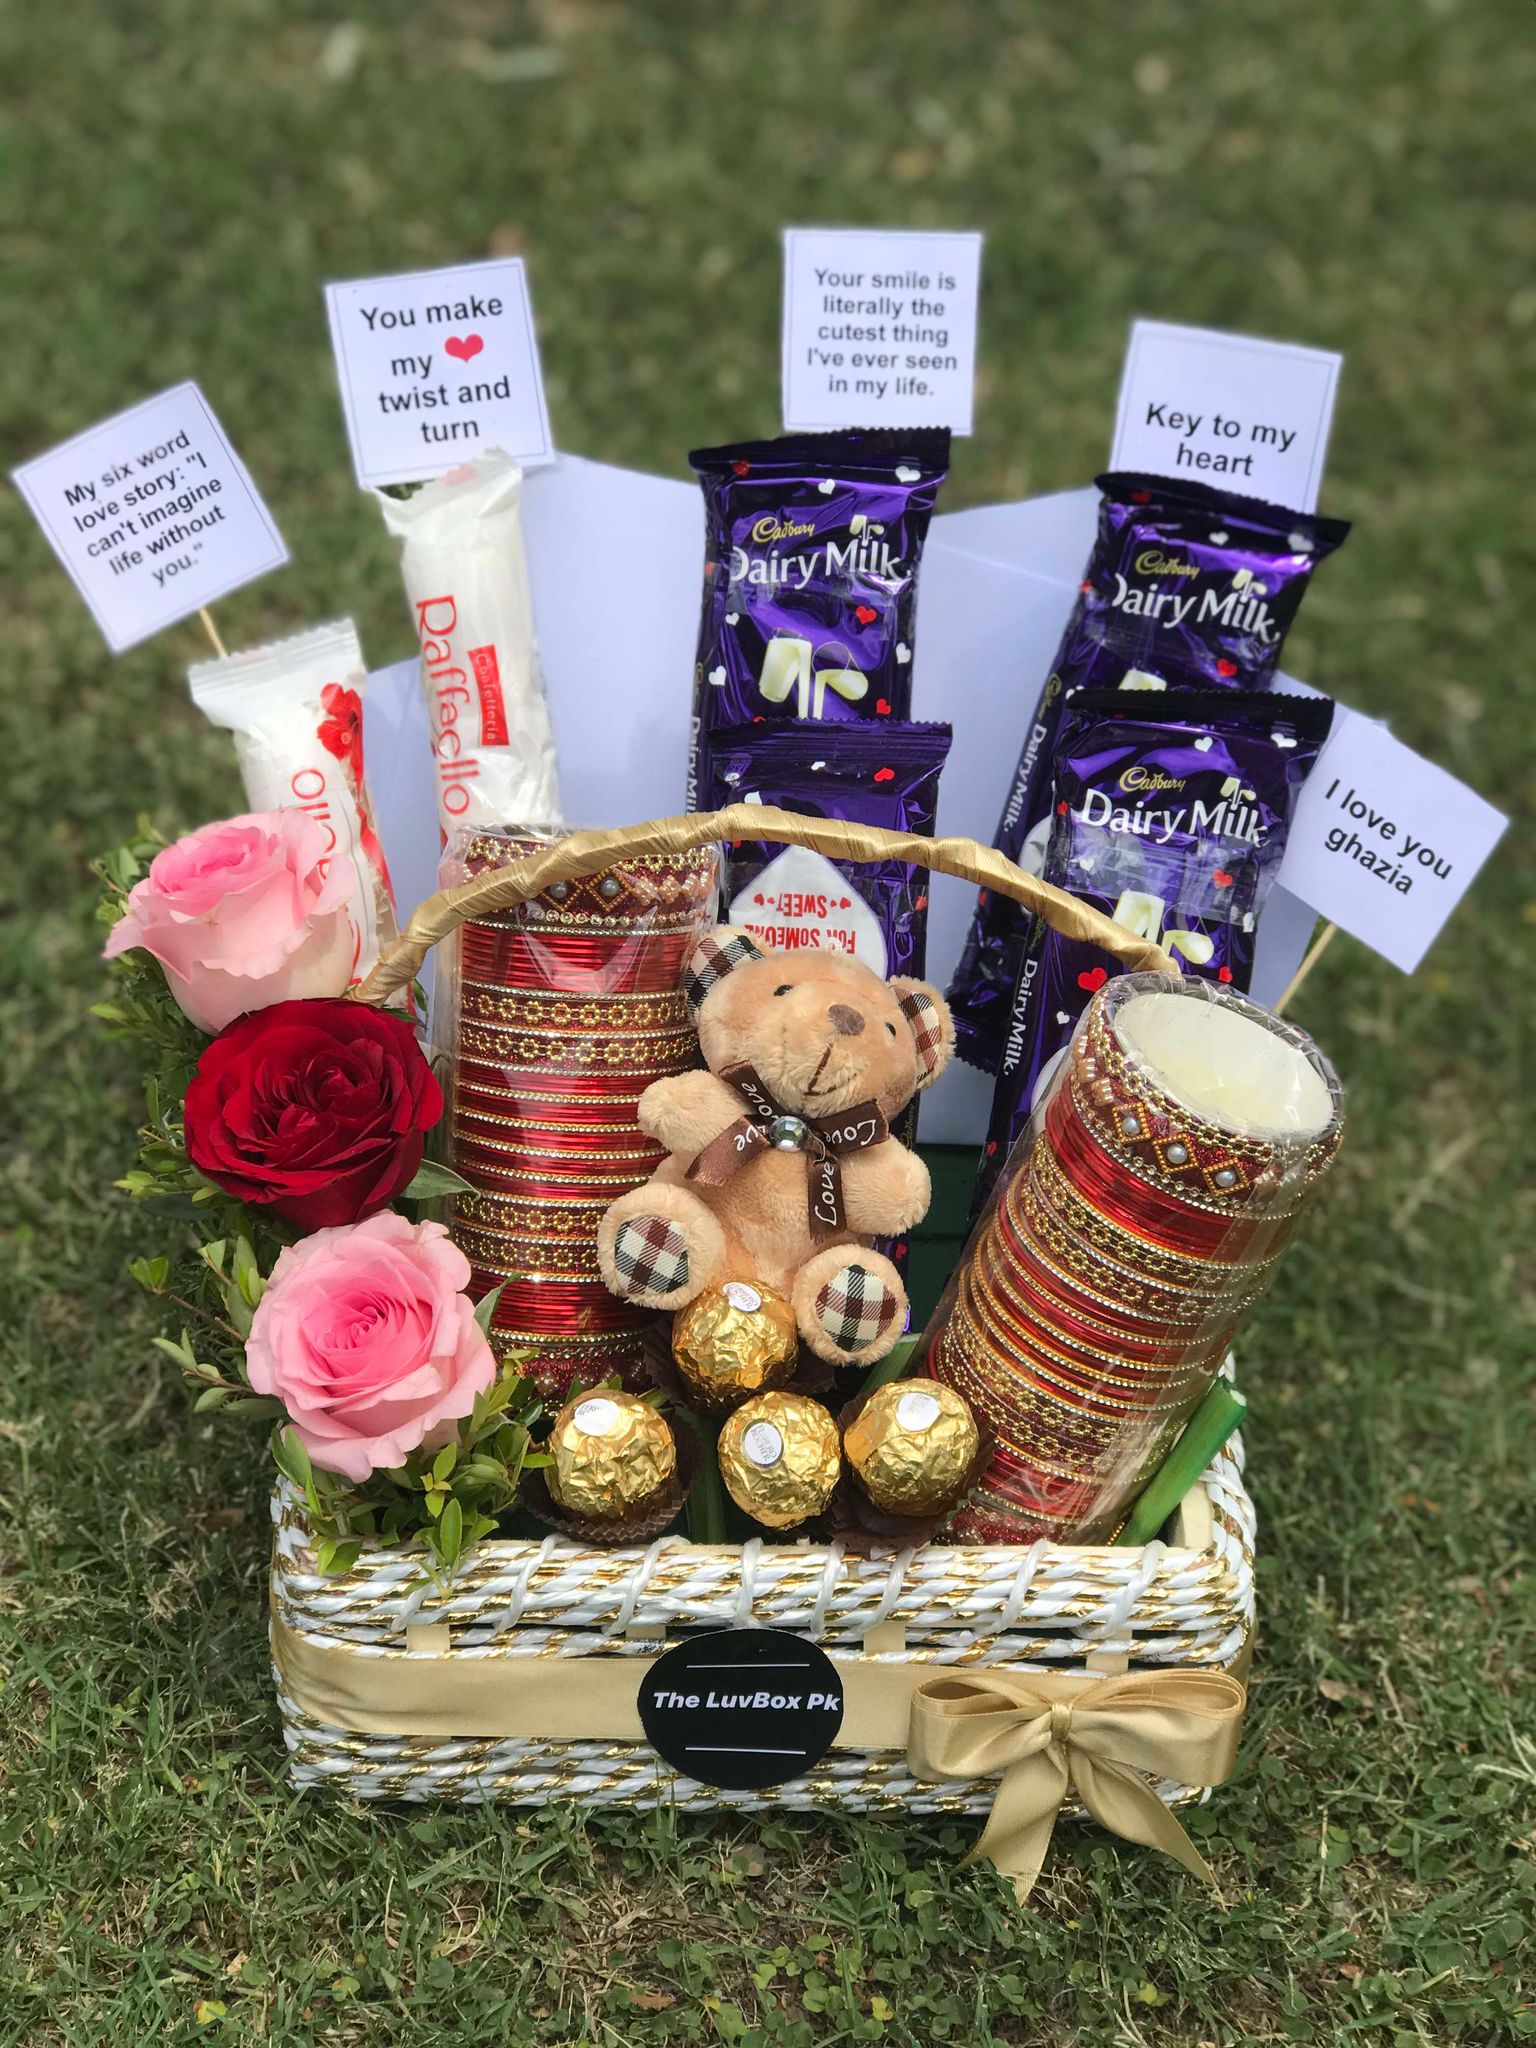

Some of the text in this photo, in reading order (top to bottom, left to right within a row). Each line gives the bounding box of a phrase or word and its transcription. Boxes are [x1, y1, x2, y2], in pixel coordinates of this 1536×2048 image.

[814, 268, 956, 290] Your smile is
[360, 294, 504, 331] You make
[823, 295, 945, 320] literally the
[818, 324, 949, 348] cutest thing
[391, 354, 433, 380] my
[807, 347, 957, 371] I've ever seen
[378, 375, 511, 414] twist and
[828, 374, 935, 399] in my life.
[420, 419, 480, 443] turn
[1146, 403, 1297, 452] Key to my
[63, 430, 191, 507] My six word
[1176, 442, 1254, 476] heart
[73, 501, 120, 533] love
[124, 466, 185, 508] story:
[86, 477, 223, 558] can't imagine
[109, 504, 227, 575] life without
[752, 516, 815, 543] Cadbury
[1135, 550, 1200, 579] Cadbury
[416, 595, 480, 815] Raffaello
[1016, 722, 1048, 786] Dairy
[686, 778, 698, 816] Mil
[1119, 766, 1186, 792] Cadbury
[1081, 788, 1186, 844] Dairy
[1325, 779, 1453, 880] I love you
[1325, 827, 1414, 895] ghazia
[776, 893, 827, 919] SWEET
[1012, 959, 1038, 1022] Dairy
[815, 1161, 837, 1227] Love
[653, 1691, 841, 1711] The LuvBox Pk
